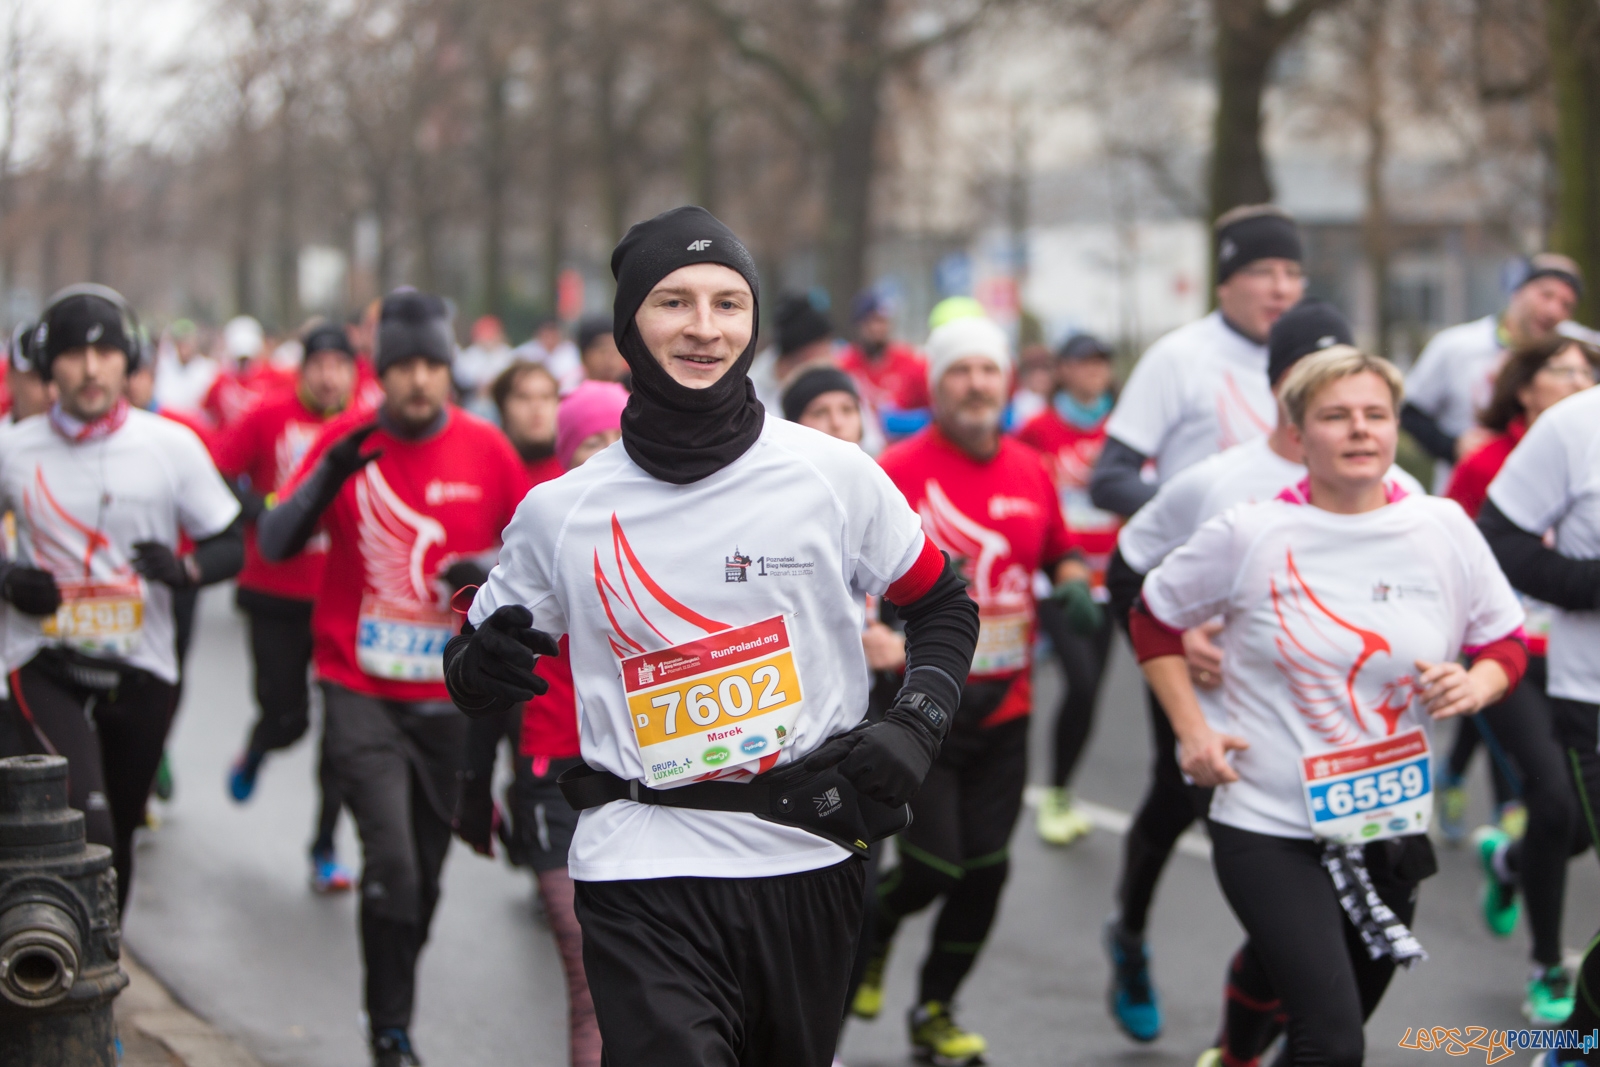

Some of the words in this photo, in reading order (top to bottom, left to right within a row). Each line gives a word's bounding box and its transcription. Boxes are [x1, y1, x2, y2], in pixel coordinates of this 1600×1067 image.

[686, 239, 713, 251] 4F
[757, 556, 768, 577] 1
[710, 633, 779, 659] RunPoland.org
[657, 662, 667, 677] 1
[636, 713, 650, 728] D
[650, 664, 787, 736] 7602
[707, 726, 743, 743] Marek
[651, 760, 678, 772] GRUPA
[653, 766, 684, 780] LUXMED
[1312, 797, 1326, 811] E
[1326, 764, 1424, 816] 6559
[818, 802, 843, 818] karrimor
